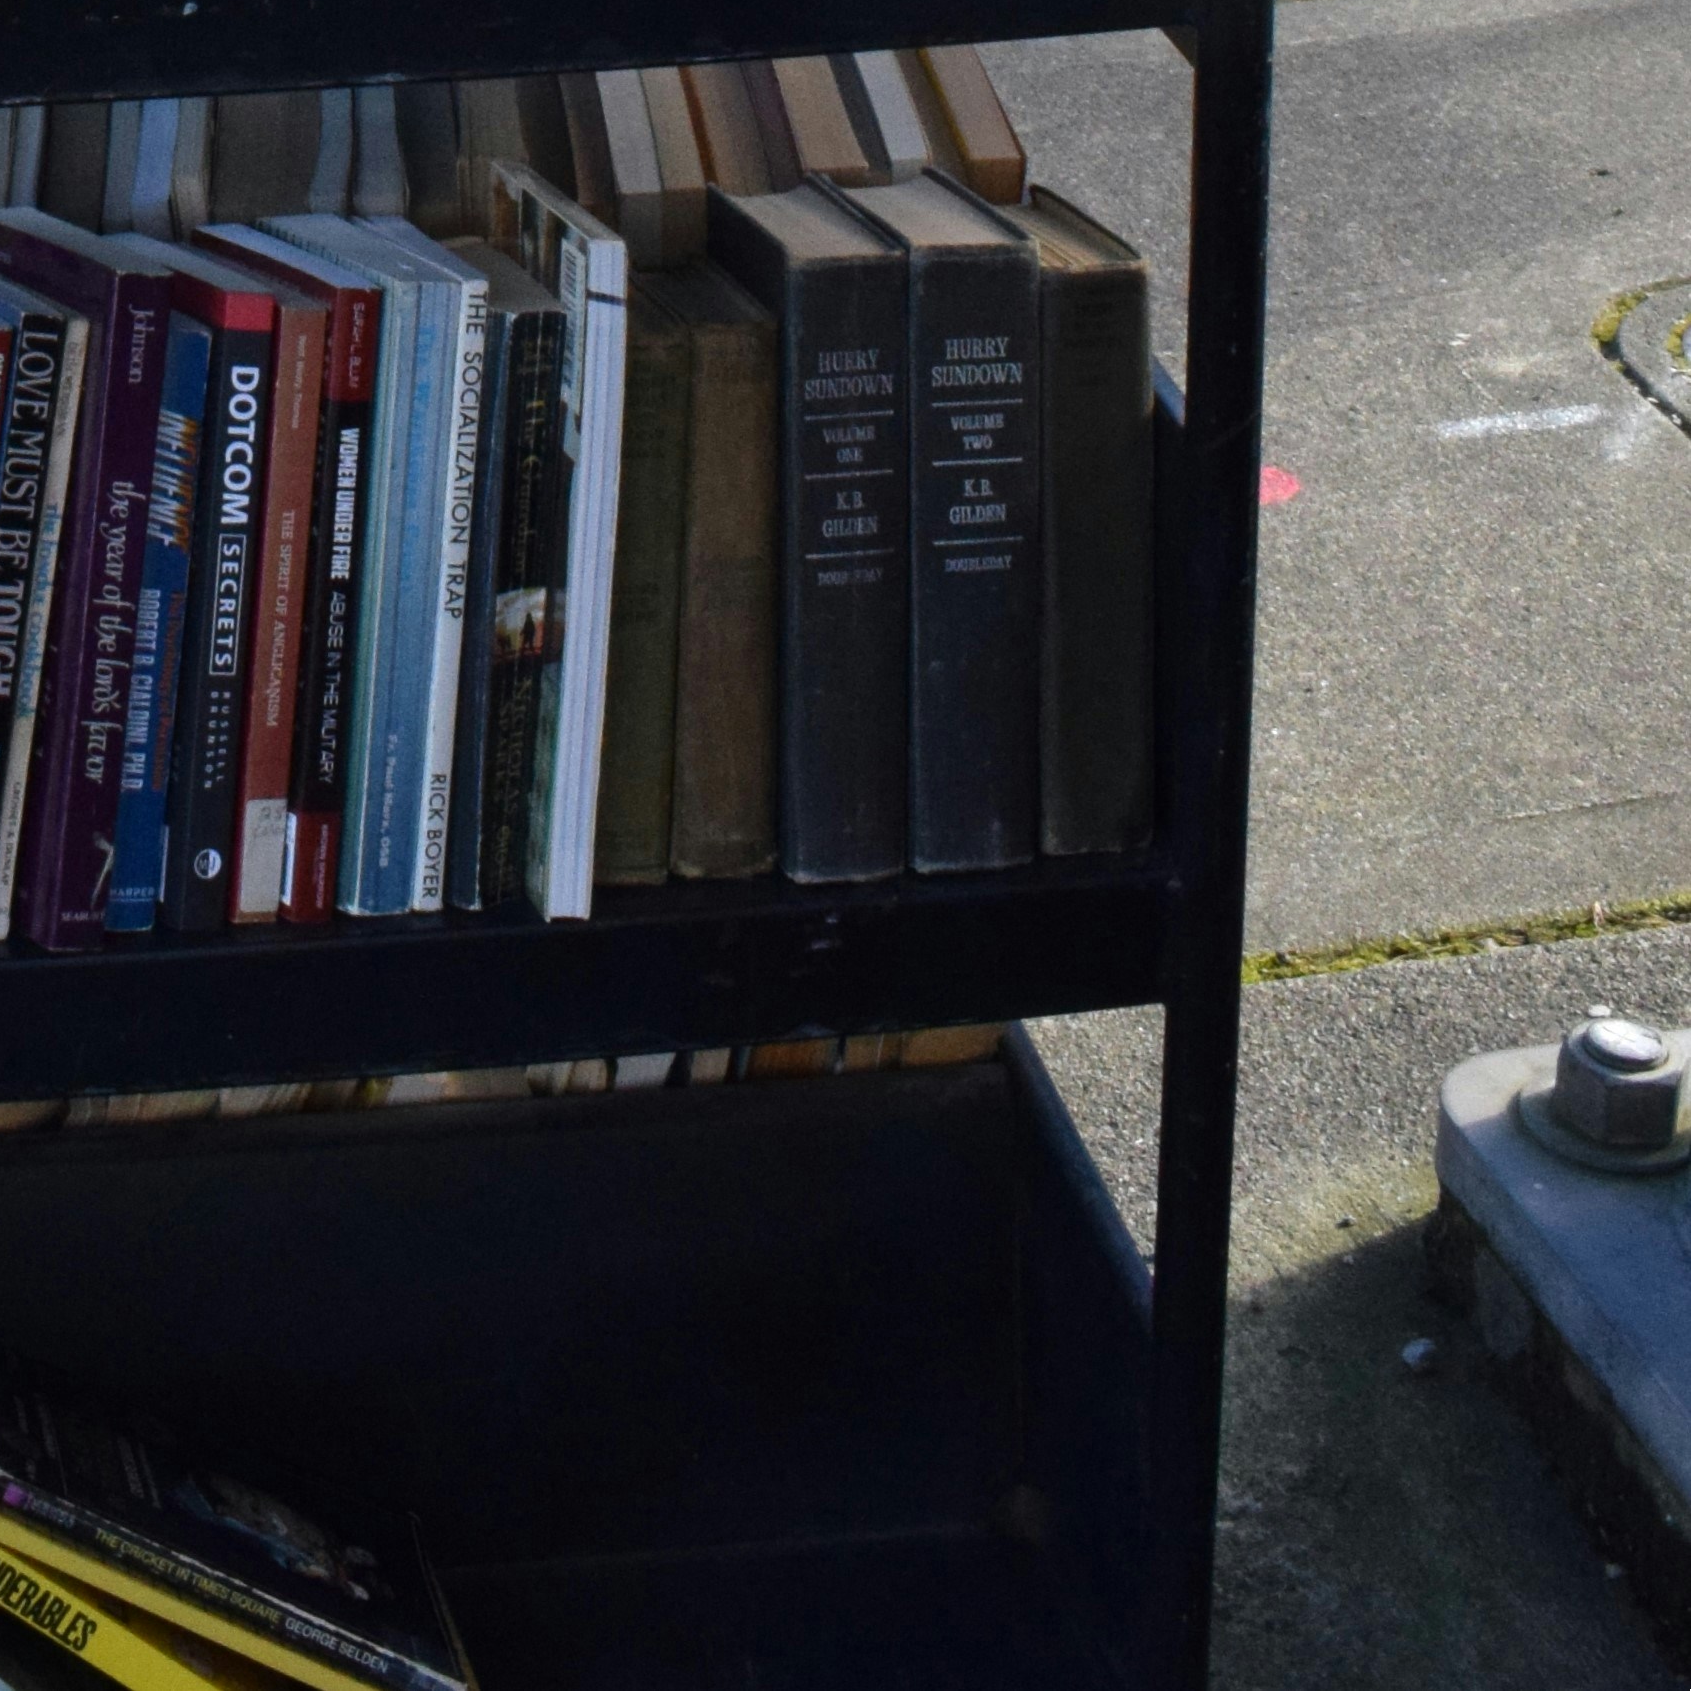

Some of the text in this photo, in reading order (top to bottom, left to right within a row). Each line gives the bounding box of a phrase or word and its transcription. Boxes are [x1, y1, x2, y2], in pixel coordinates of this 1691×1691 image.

[9, 330, 57, 427] LOVE
[122, 305, 156, 385] Johnson
[804, 374, 894, 400] SUNDOWN
[931, 362, 1023, 387] SUNDOWN
[945, 336, 1008, 359] HURRY
[444, 291, 486, 619] THE SOCIALIZATION TRAP
[823, 425, 875, 444] VOLUME
[950, 413, 1004, 431] VOLUME
[962, 435, 993, 451] TWO
[143, 409, 203, 553] INFLUENCE
[212, 365, 259, 668] DOTCOM SECRETS
[949, 503, 1006, 525] GILDEN
[317, 426, 358, 782] WOMEN UNDER FIRE ABUSE IN THE MILITARY
[944, 555, 1012, 573] DOUBLEDAY
[264, 508, 294, 726] THE SPIRIT OF ANGLICANISM
[202, 690, 219, 789] BRUNSON
[213, 691, 230, 784] RUSSELL
[420, 773, 446, 897] RICK BOYER
[92, 1525, 389, 1674] THE CRICKET IN TIMES SQUARE GEORGE SELDEN
